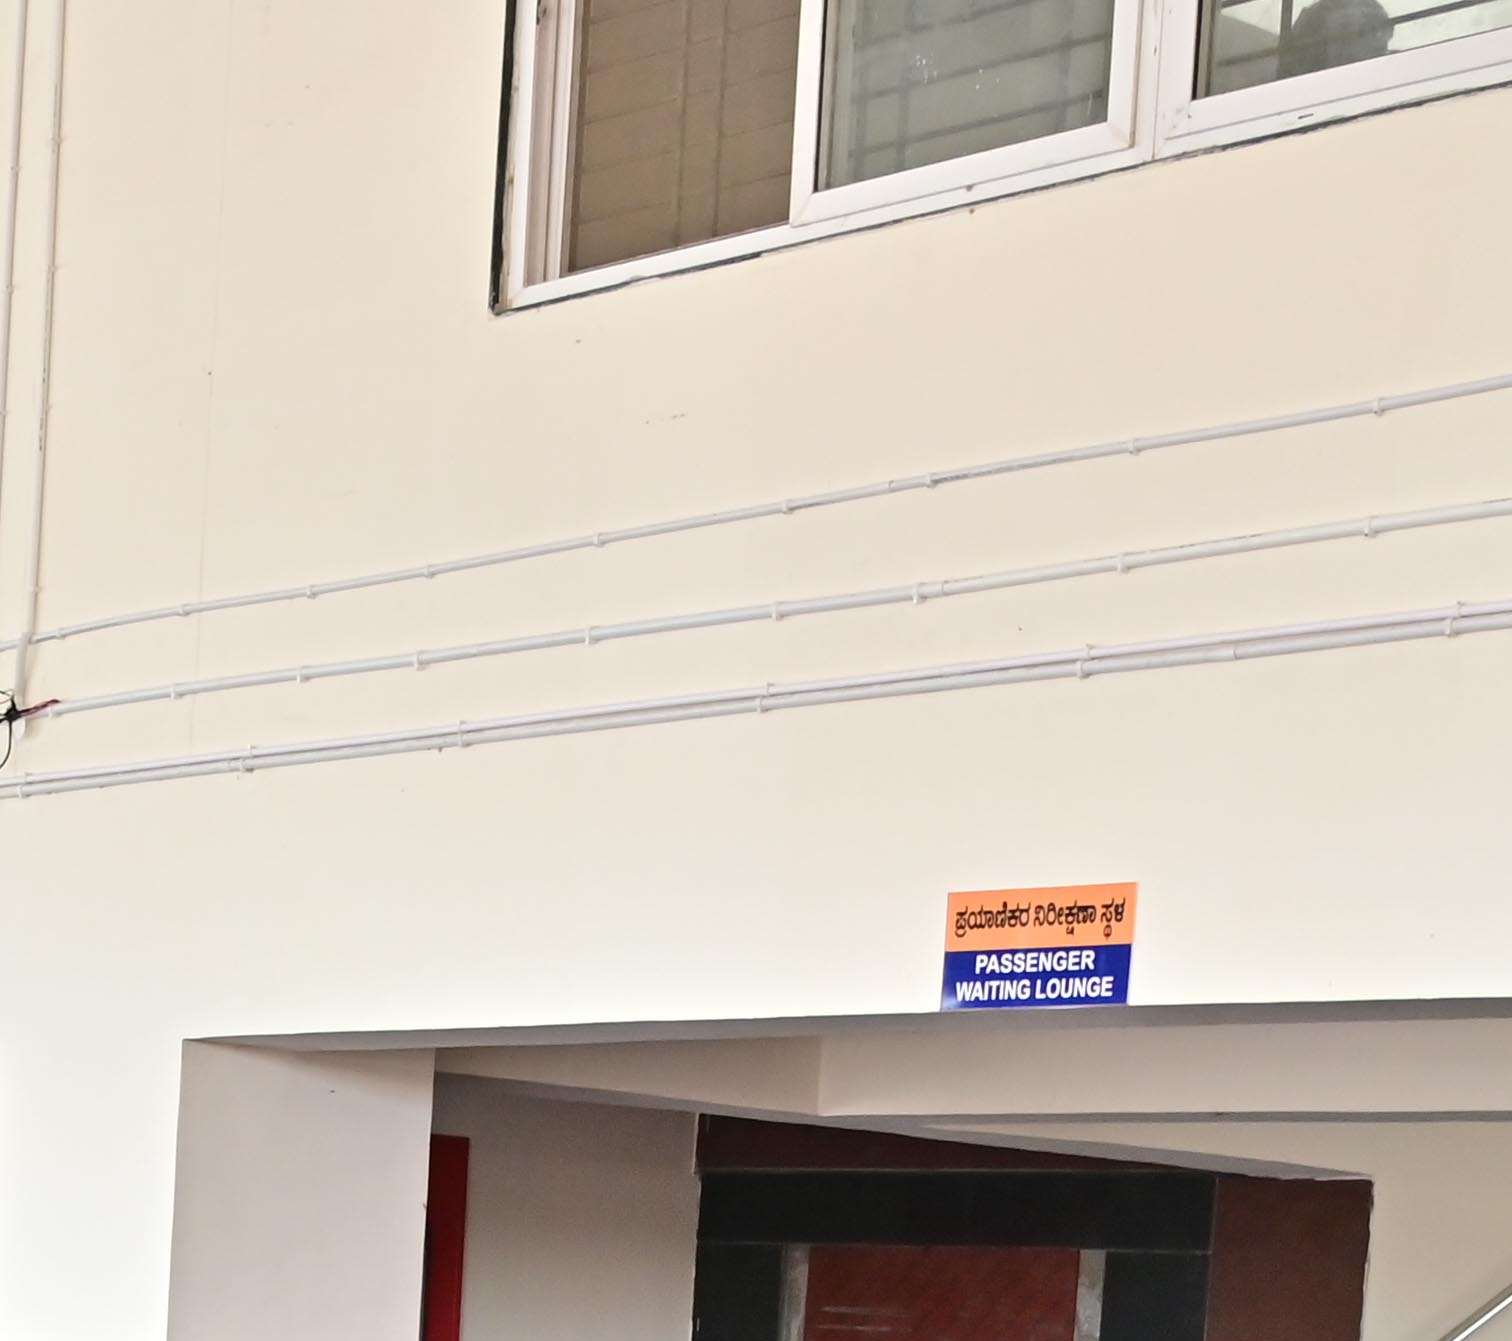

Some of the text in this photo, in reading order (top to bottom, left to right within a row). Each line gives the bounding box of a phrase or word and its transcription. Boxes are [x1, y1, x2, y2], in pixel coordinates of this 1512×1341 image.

[955, 901, 1030, 937] ಪ್ರಯಾಣಿಕರ
[975, 950, 1095, 974] PASSENGER
[956, 976, 1114, 1002] WAITING LOUNGE
